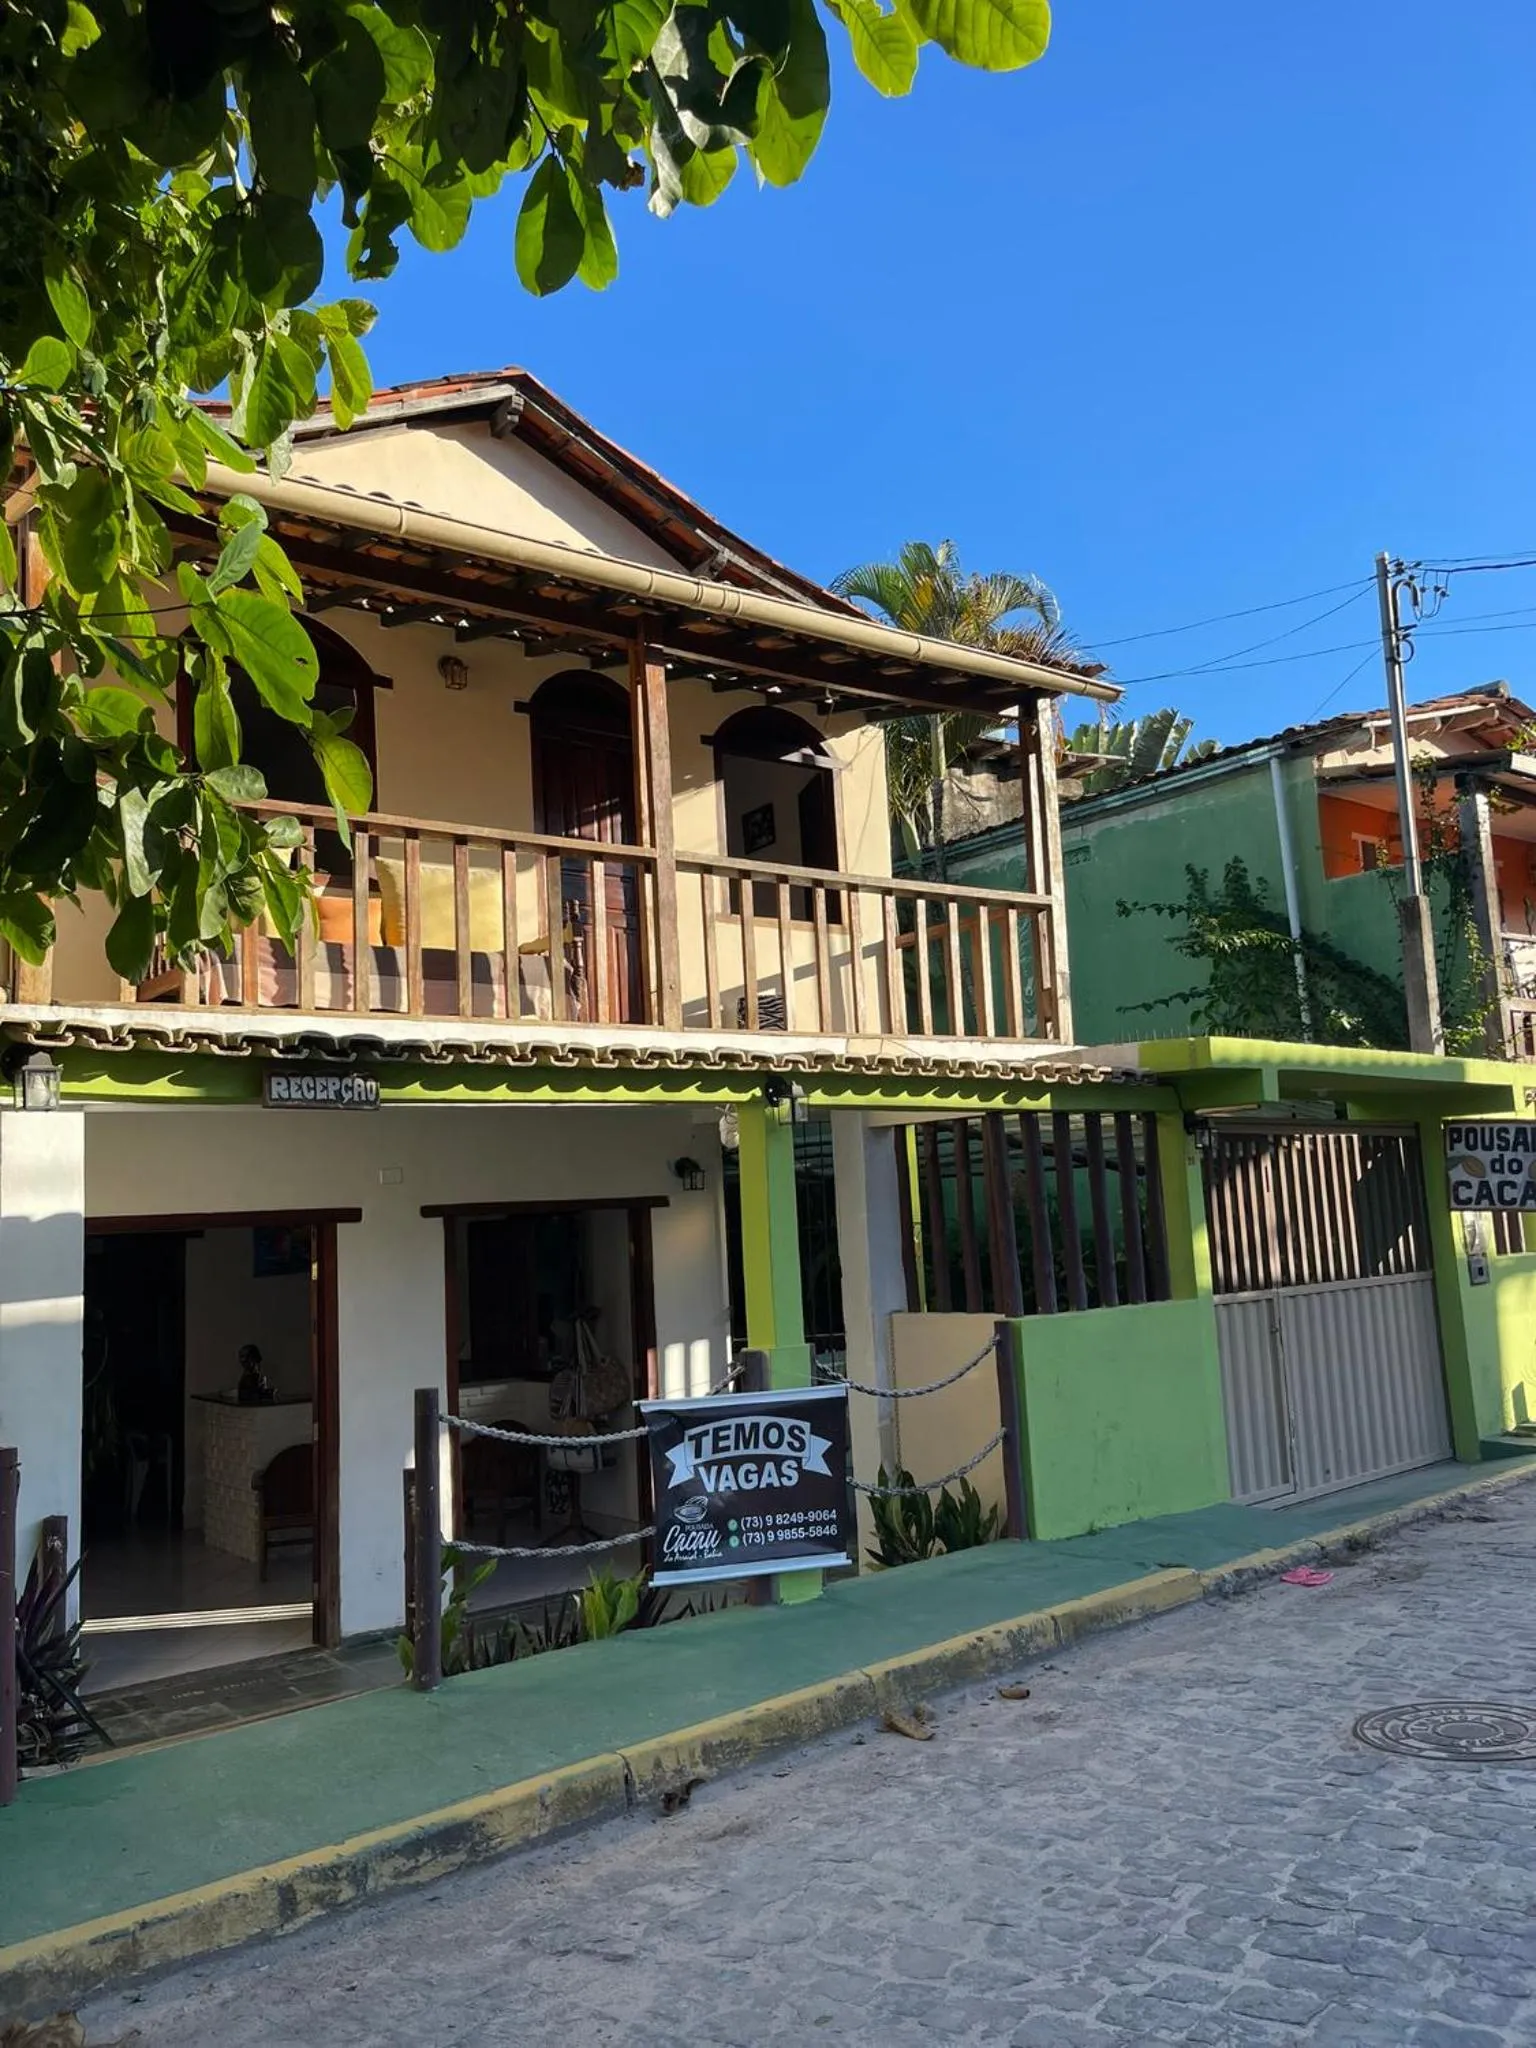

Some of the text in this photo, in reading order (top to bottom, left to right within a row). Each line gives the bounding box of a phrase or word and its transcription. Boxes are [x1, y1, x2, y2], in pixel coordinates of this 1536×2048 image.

[1490, 1153, 1523, 1175] do
[1452, 1180, 1536, 1207] CACA
[688, 1421, 806, 1459] TEMOS
[698, 1459, 800, 1493] VAGAS
[741, 1509, 837, 1531] (73) 9 8249-9064
[663, 1524, 722, 1553] Cacau
[742, 1524, 838, 1547] (73) 9 9855-5846
